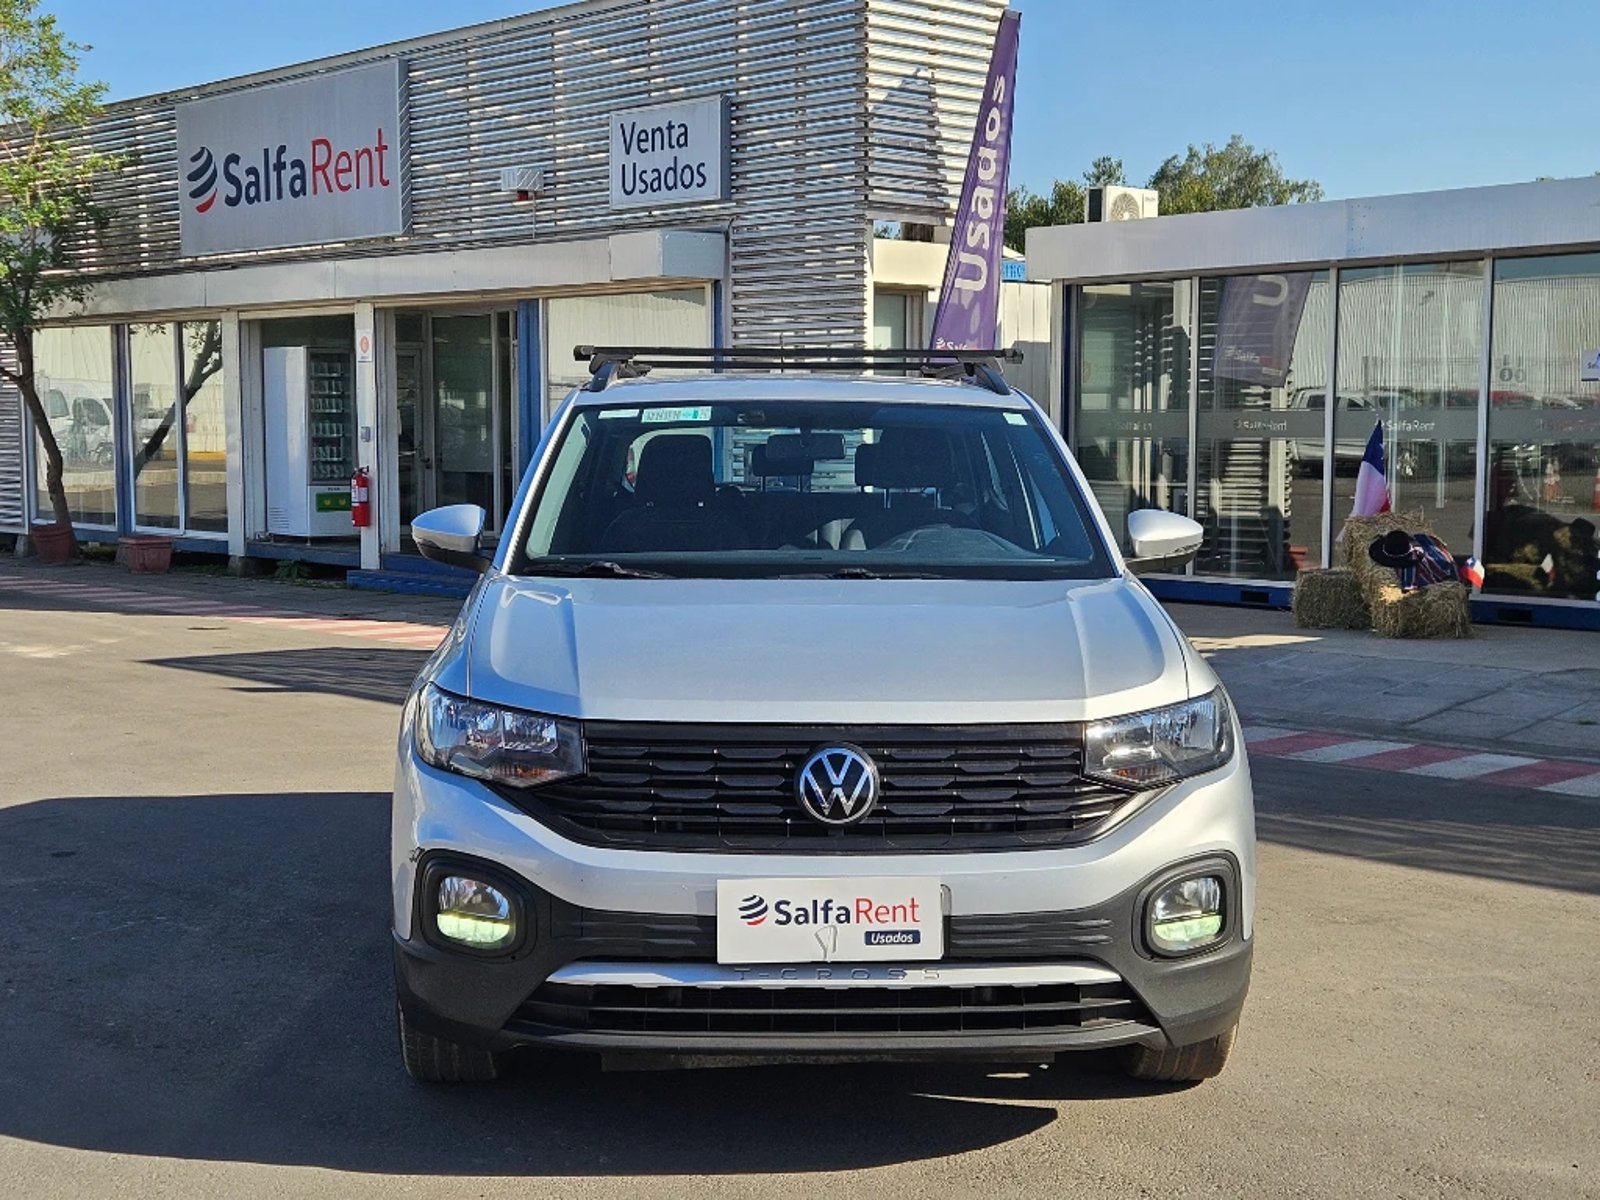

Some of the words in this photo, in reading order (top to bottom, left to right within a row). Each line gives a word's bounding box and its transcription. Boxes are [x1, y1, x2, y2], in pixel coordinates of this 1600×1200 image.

[620, 120, 689, 156] Venta
[621, 156, 707, 196] Usados
[870, 931, 914, 945] Usados
[734, 968, 941, 981] T-CROSS
